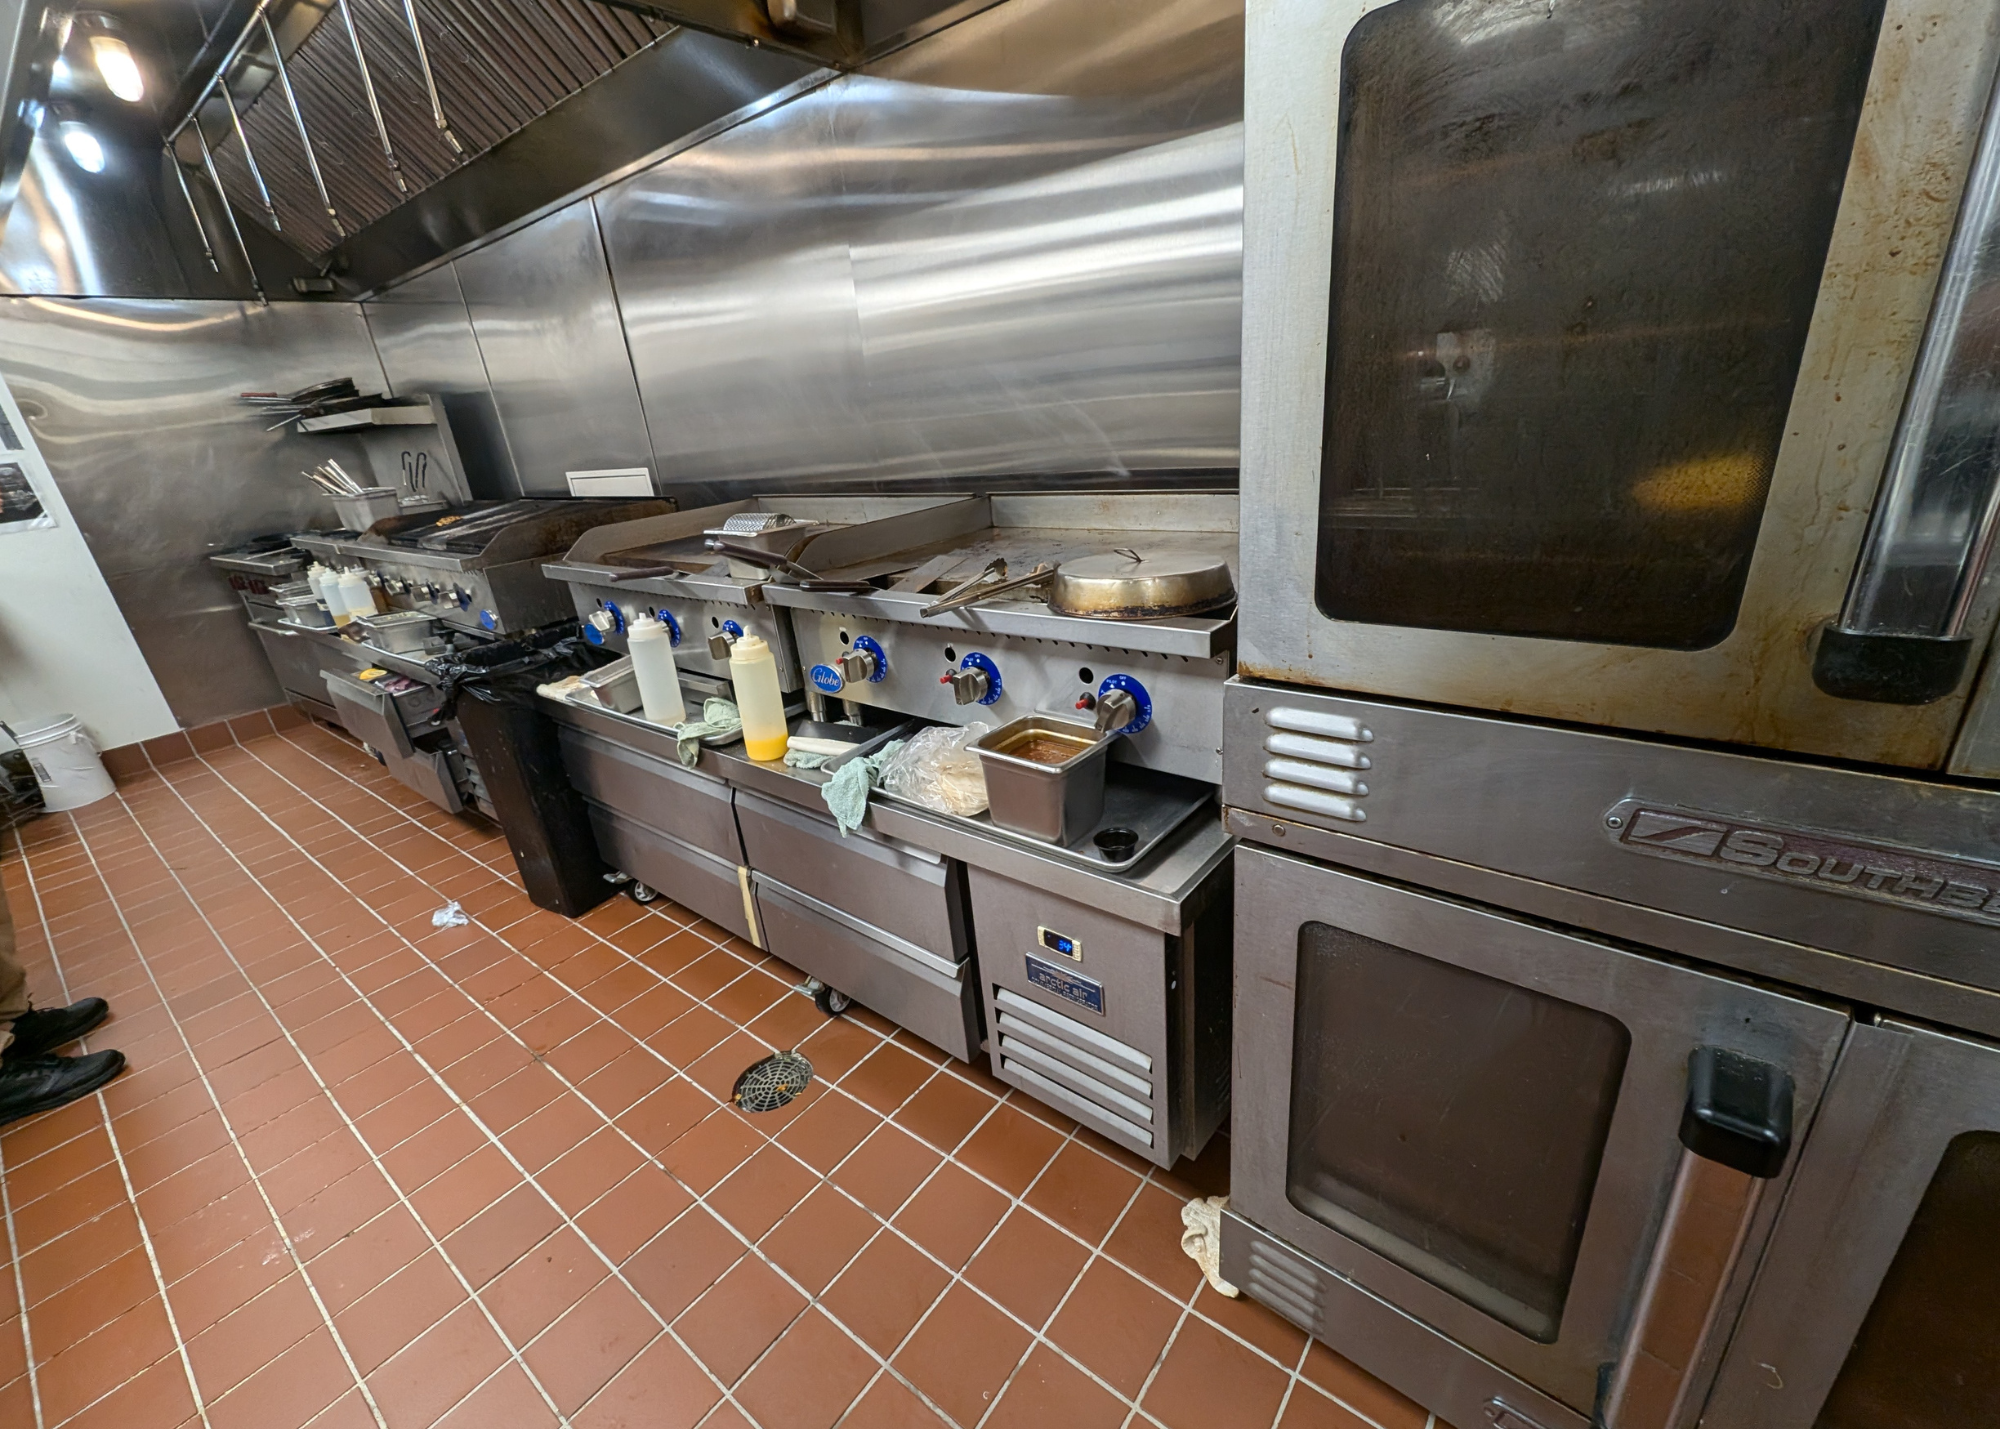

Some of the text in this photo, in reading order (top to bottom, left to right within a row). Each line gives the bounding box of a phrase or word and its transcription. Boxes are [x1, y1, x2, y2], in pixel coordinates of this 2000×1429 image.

[812, 668, 840, 687] Globe
[1058, 940, 1072, 952] 34
[1039, 972, 1070, 993] arctic
[1072, 987, 1088, 999] air
